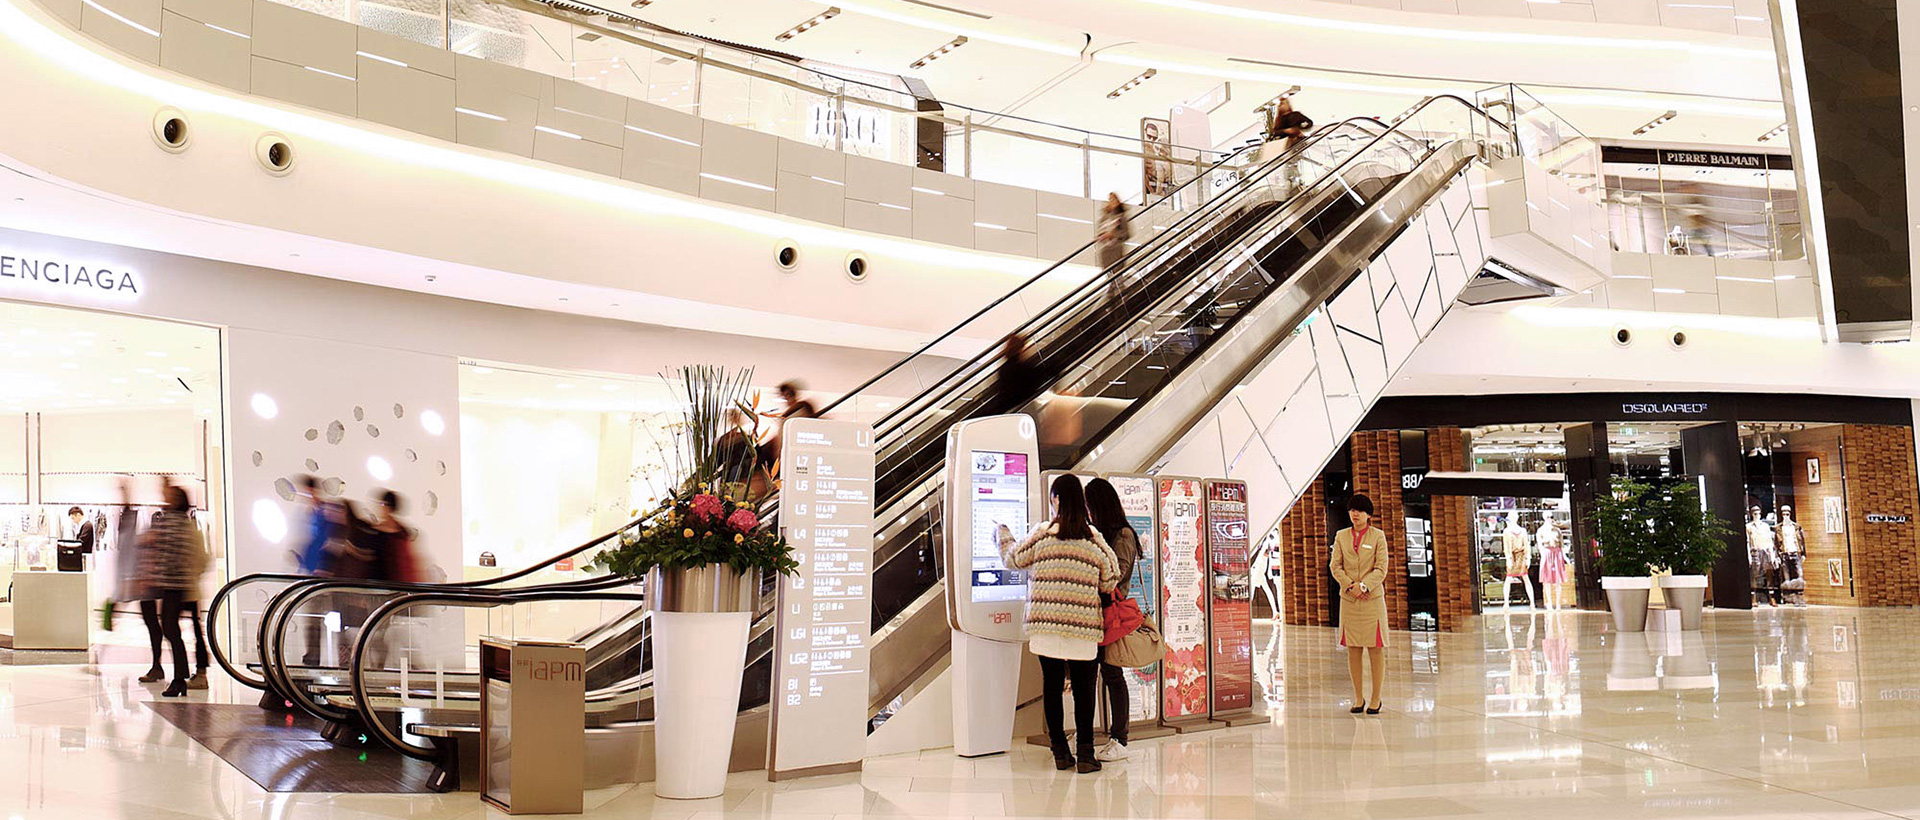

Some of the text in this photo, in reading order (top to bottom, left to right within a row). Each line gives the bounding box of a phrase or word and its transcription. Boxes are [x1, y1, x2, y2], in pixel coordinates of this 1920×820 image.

[1667, 152, 1759, 166] PIERRE BALMAIN
[0, 255, 137, 293] ENCIAGA
[796, 455, 809, 466] L7
[795, 480, 809, 491] L6
[794, 504, 807, 515] L5
[794, 528, 807, 540] L4
[792, 577, 805, 590] L2
[789, 652, 809, 665] LG2
[786, 693, 801, 706] B2
